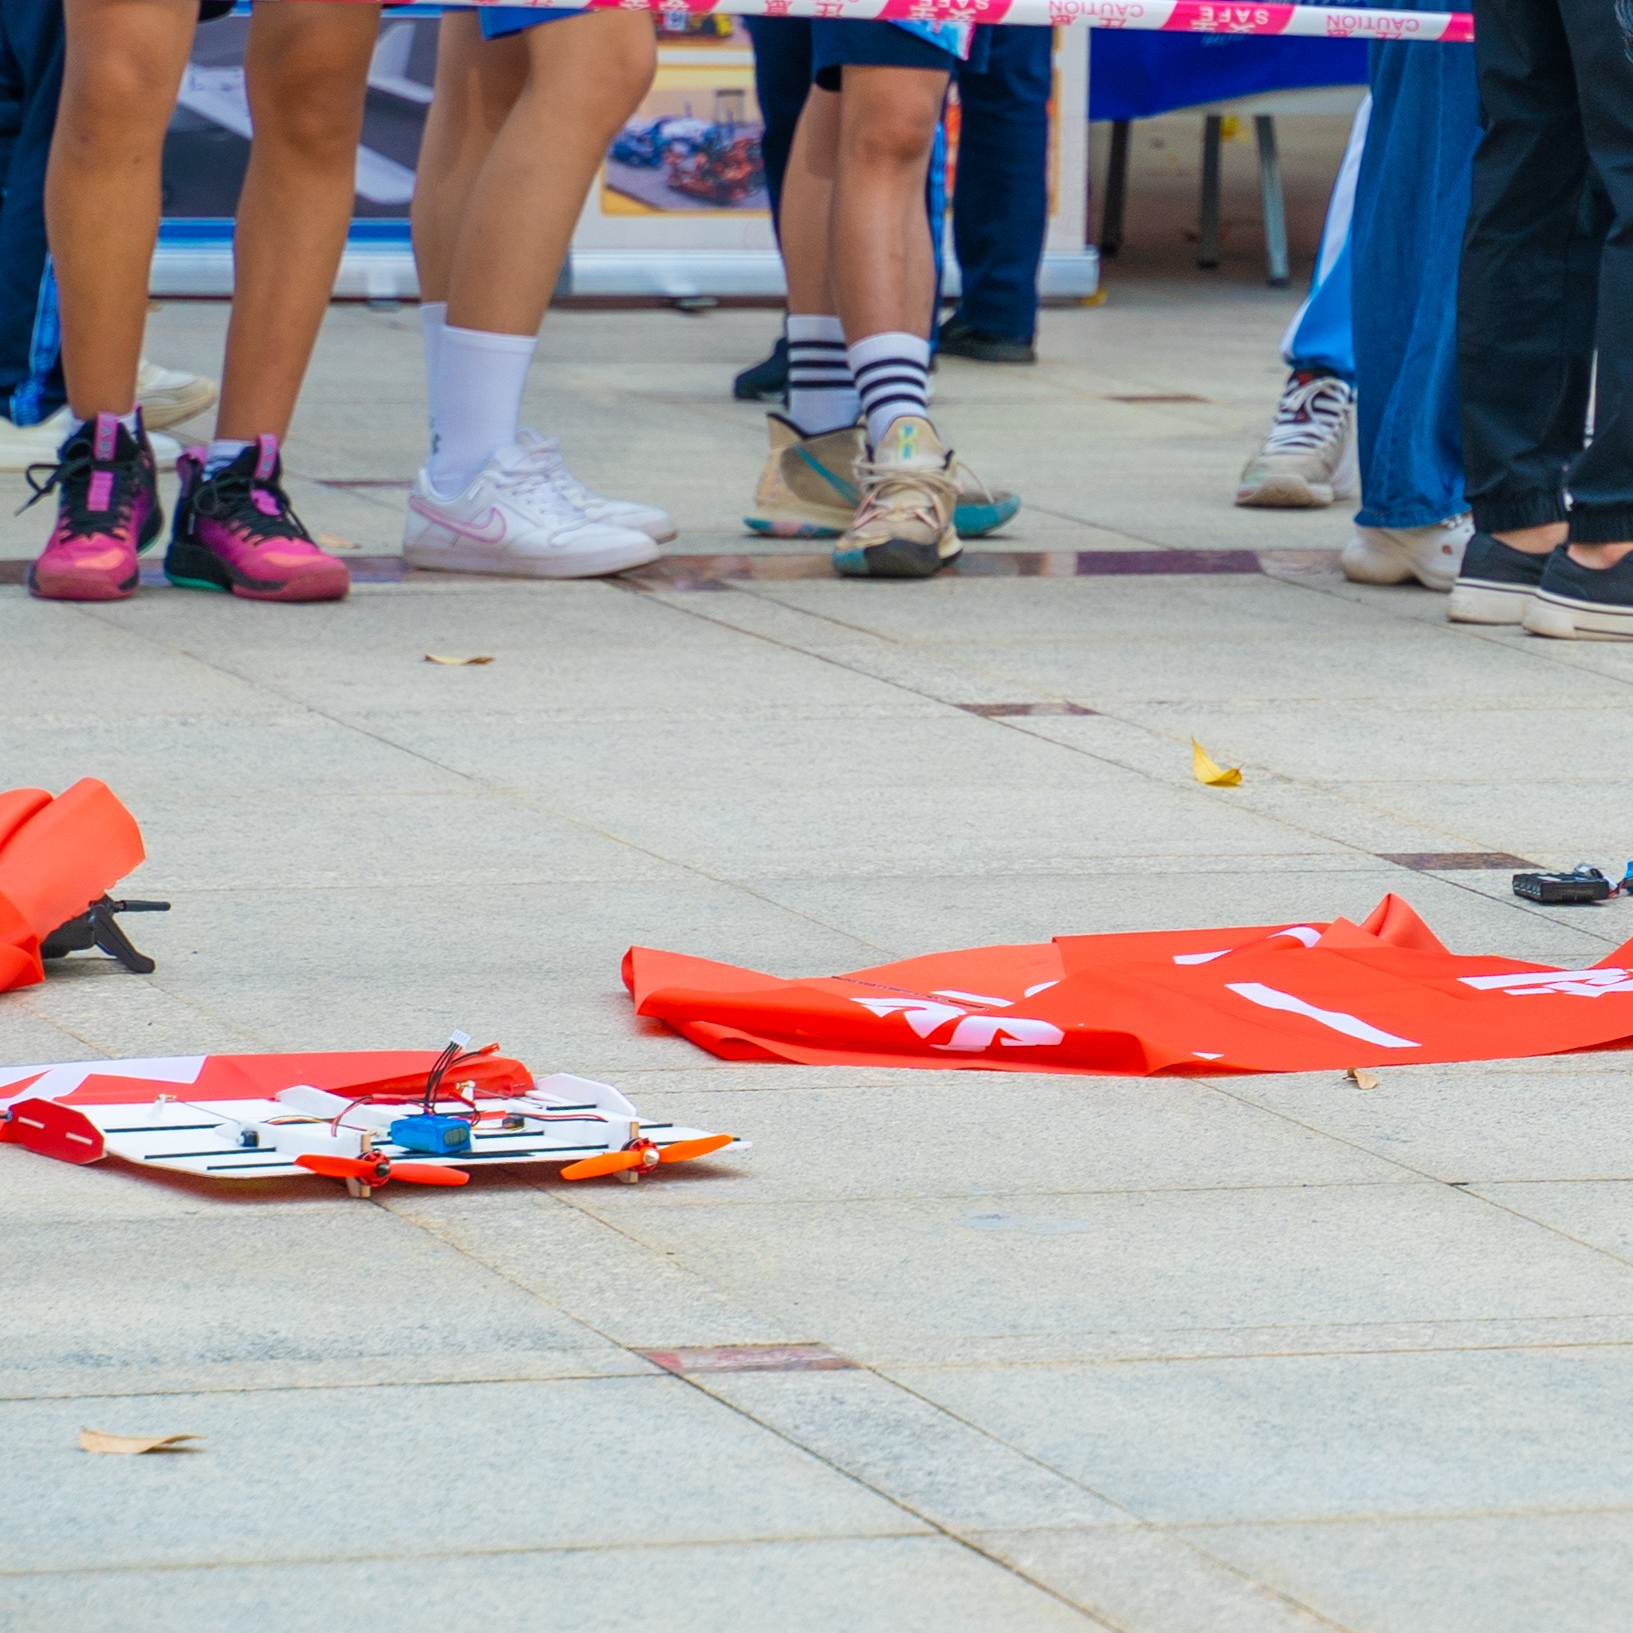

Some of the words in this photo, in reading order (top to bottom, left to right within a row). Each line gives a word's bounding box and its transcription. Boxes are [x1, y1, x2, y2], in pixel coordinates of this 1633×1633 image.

[1049, 0, 1144, 19] CAUTION
[1200, 6, 1270, 26] SAFE
[1327, 14, 1420, 34] CAUTION
